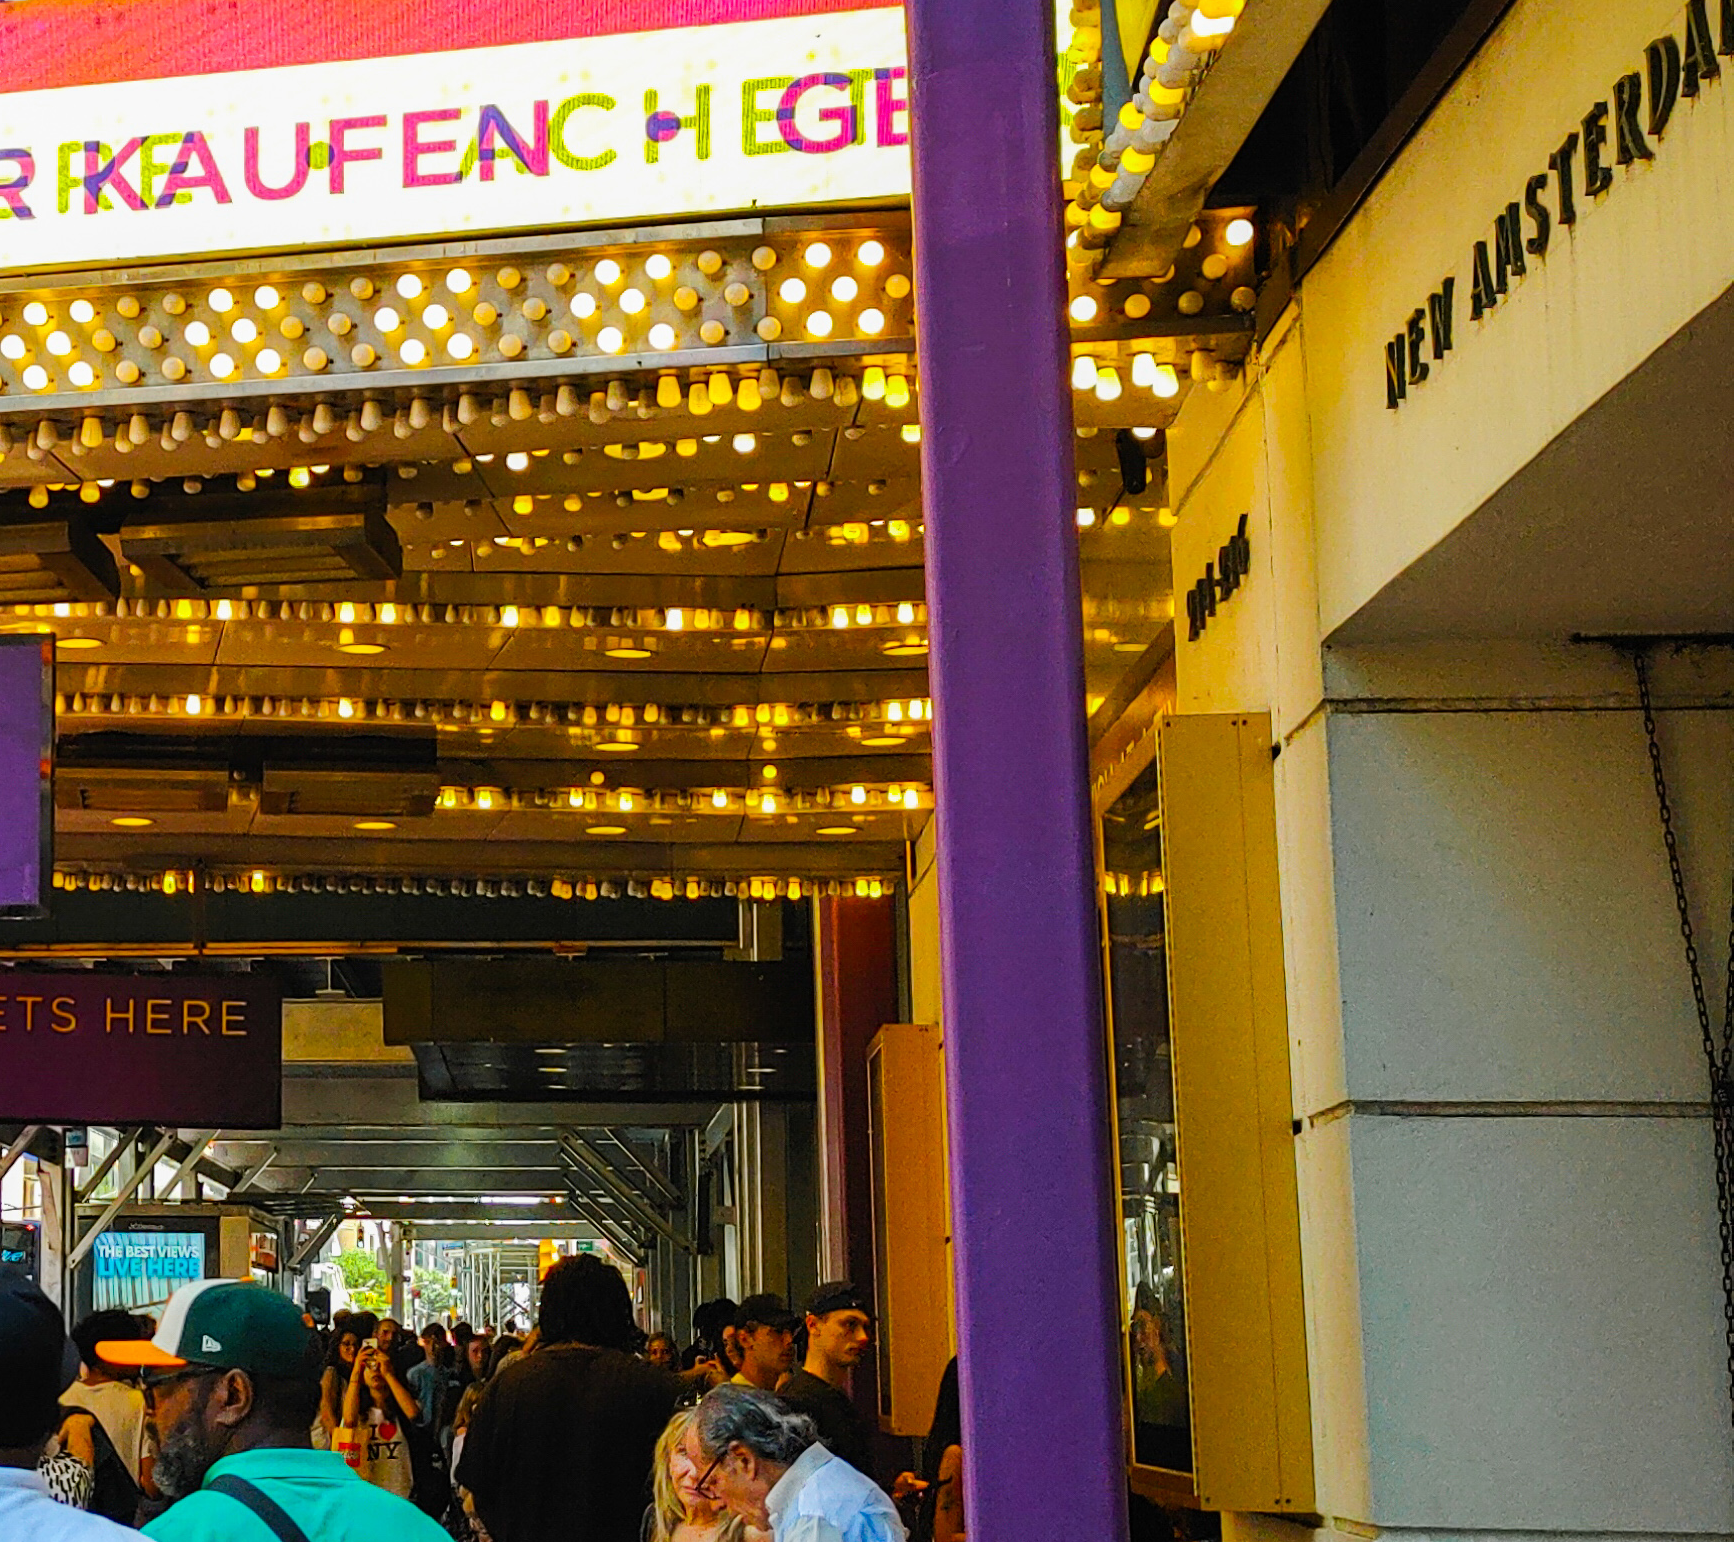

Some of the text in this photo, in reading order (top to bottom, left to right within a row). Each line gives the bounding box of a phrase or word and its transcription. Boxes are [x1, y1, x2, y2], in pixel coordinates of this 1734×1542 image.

[82, 99, 551, 216] KAUFEN
[1385, 276, 1456, 410] NEW
[105, 998, 250, 1037] HERE
[98, 1244, 200, 1259] THE BEST VIEWS
[98, 1256, 201, 1279] LIVE HERE
[369, 1423, 379, 1440] I
[366, 1441, 402, 1461] NY
